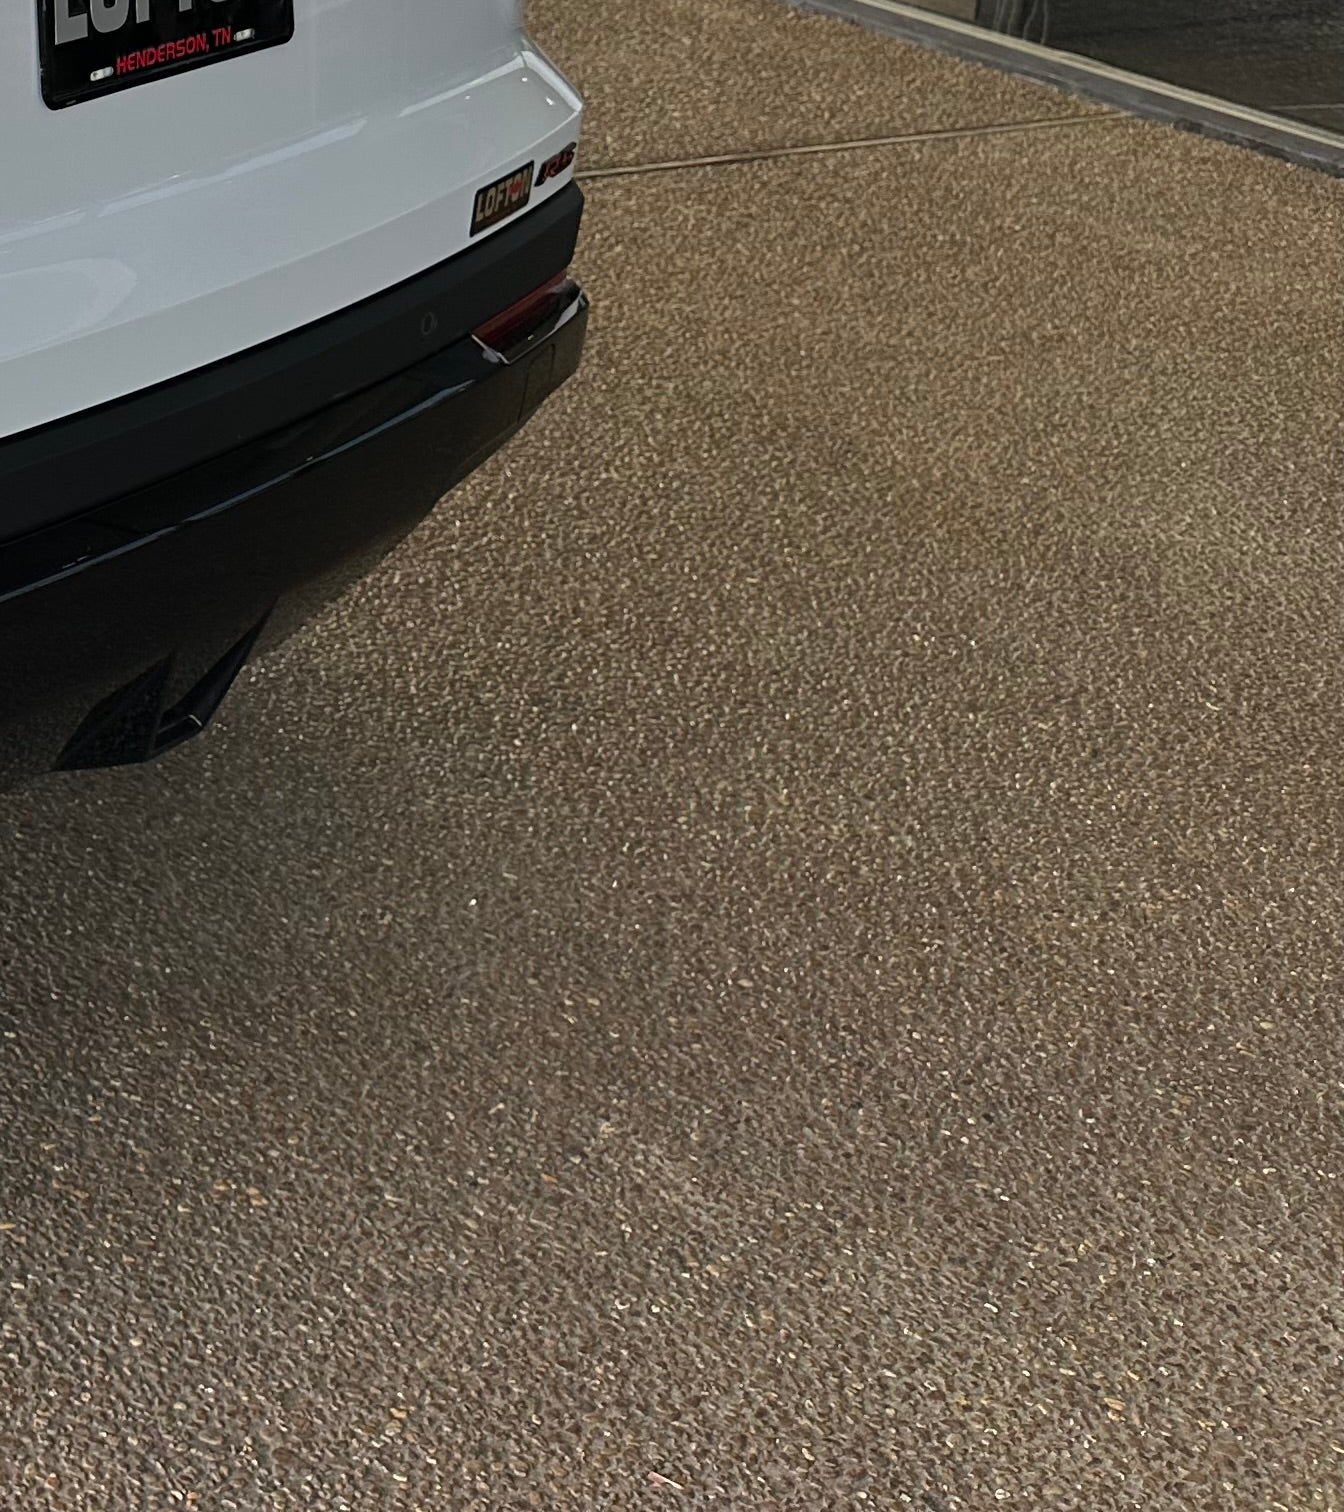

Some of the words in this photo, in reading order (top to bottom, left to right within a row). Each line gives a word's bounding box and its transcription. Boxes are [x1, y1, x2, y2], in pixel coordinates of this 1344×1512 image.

[115, 33, 210, 76] HENDERSON,
[211, 26, 232, 47] TN
[475, 165, 534, 223] LOFTON
